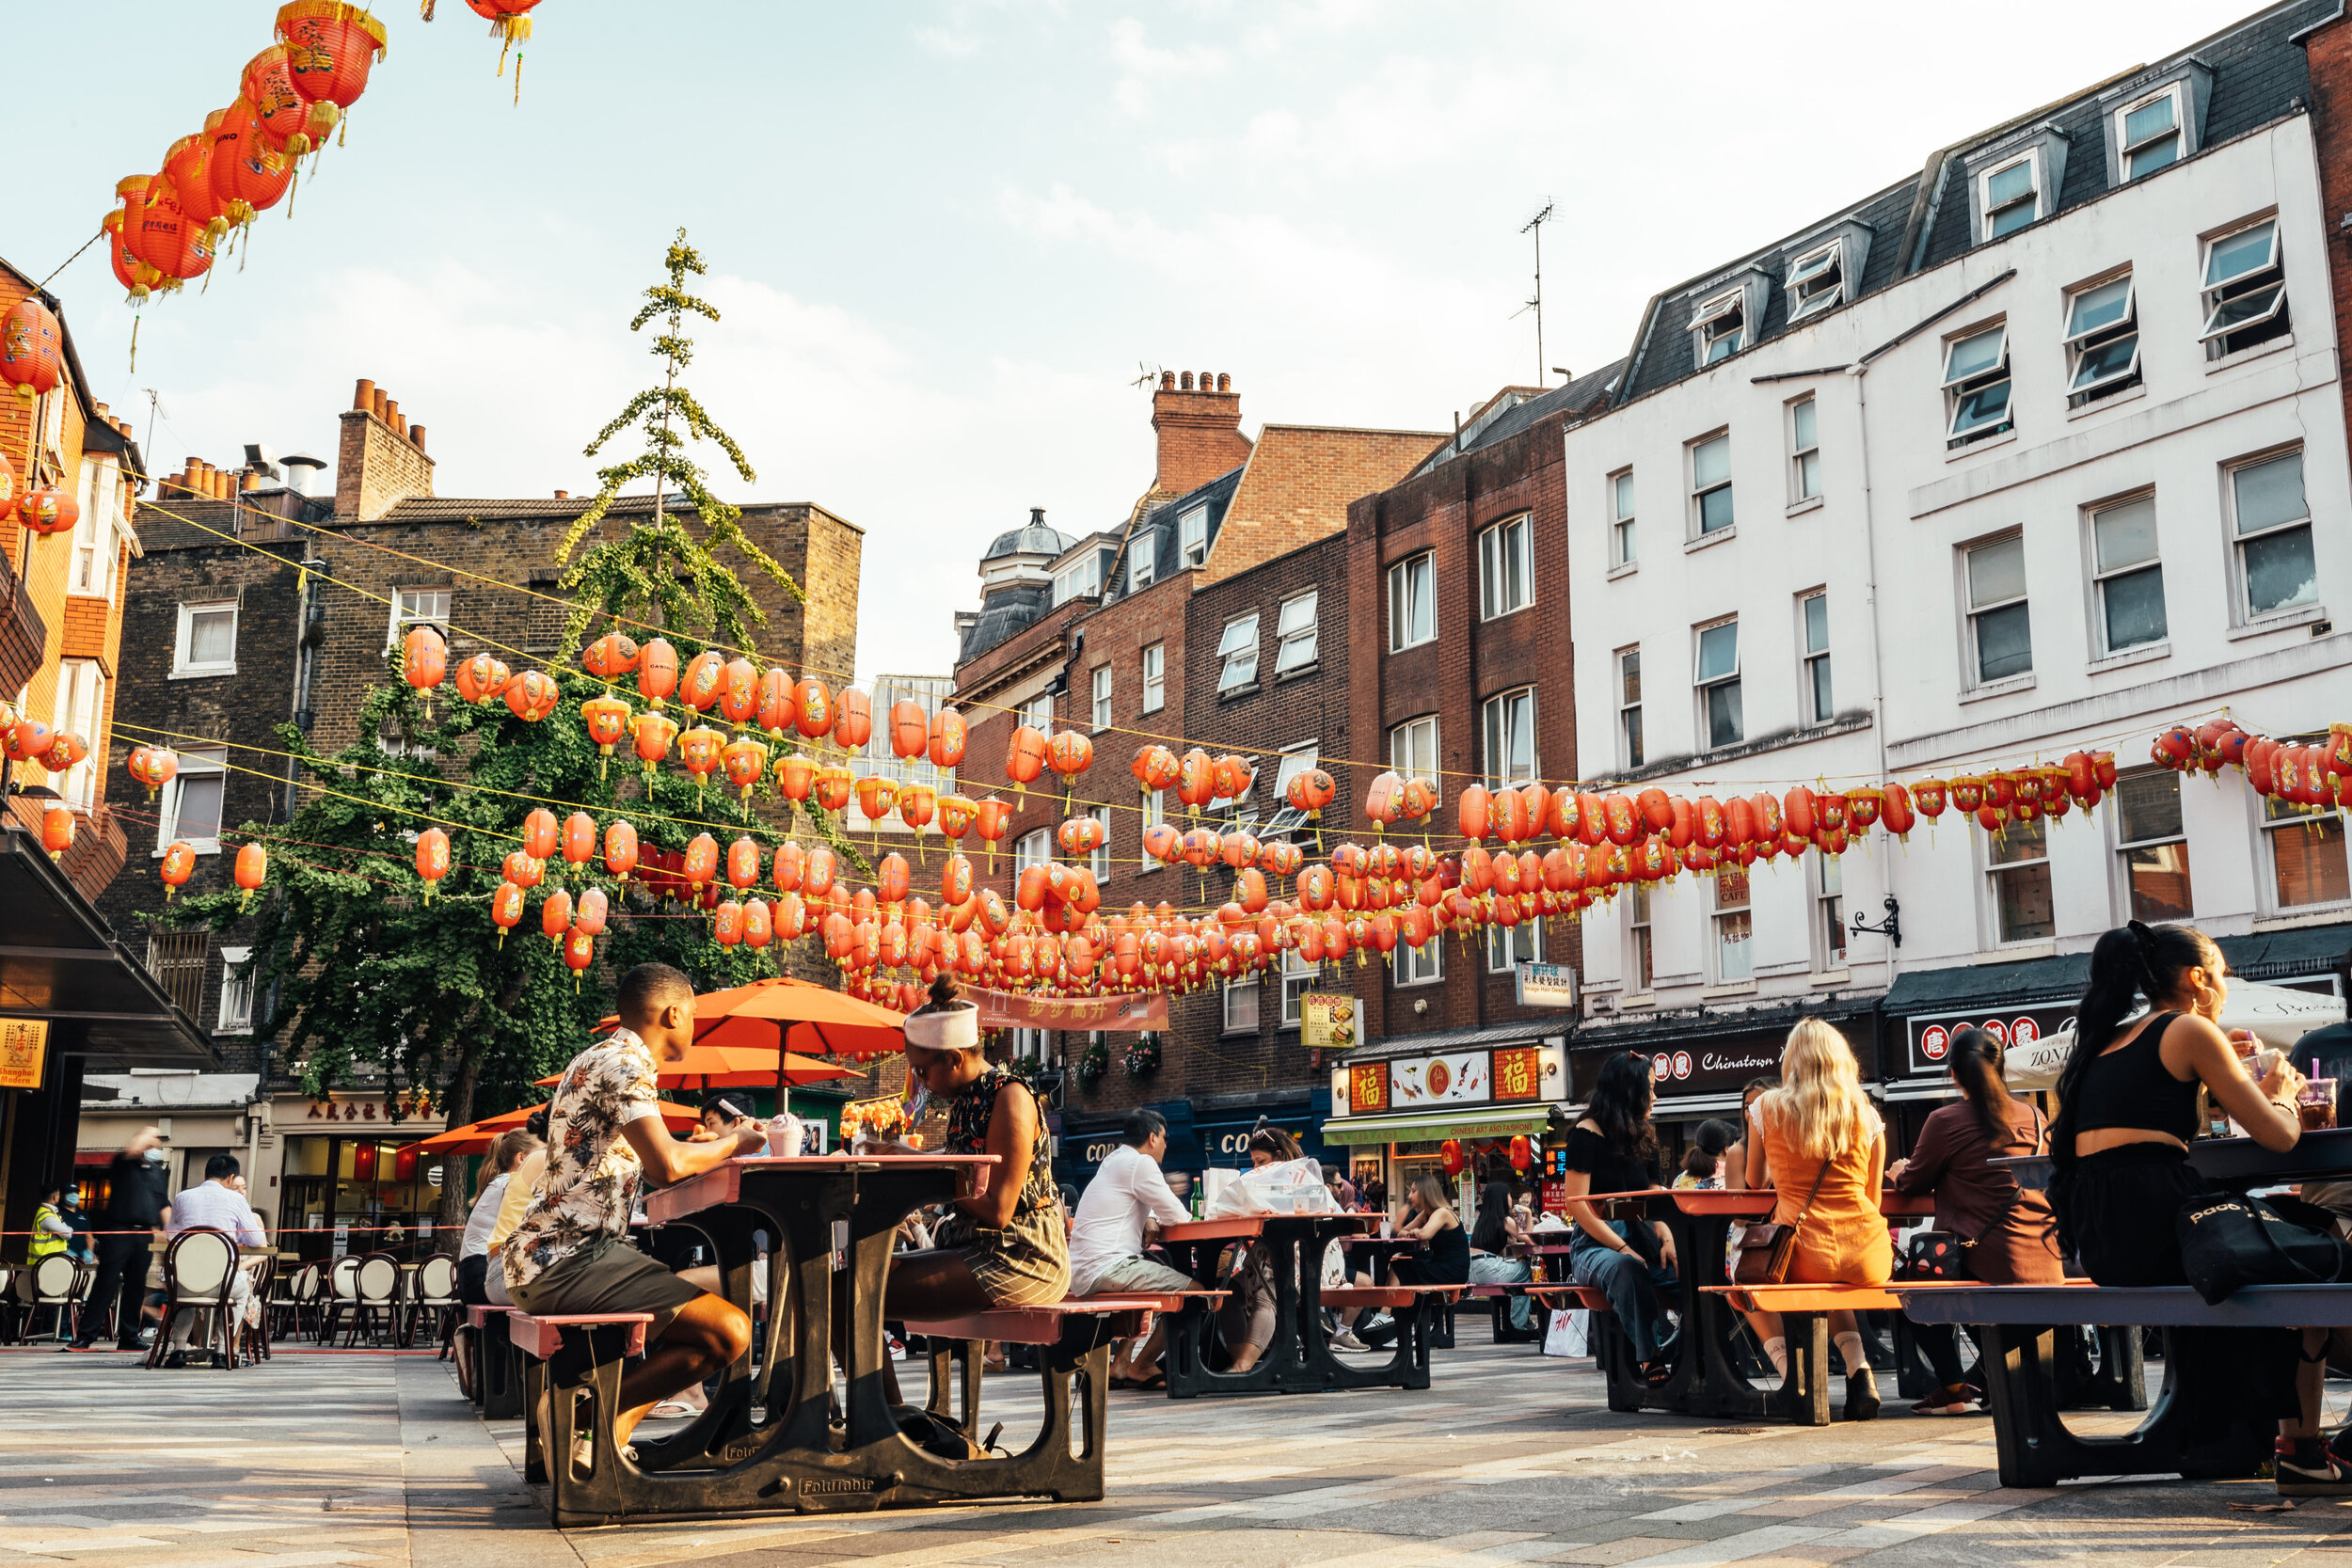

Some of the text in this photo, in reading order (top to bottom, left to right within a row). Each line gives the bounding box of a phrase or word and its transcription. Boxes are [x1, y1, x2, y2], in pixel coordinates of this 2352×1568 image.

[1019, 748, 1041, 761] CASINO
[1721, 890, 1747, 902] CAFE
[1724, 932, 1753, 945] 馬拉咖
[1551, 987, 1569, 995] Design
[1027, 999, 1108, 1021] 步步高升
[1702, 1052, 1774, 1071] Chinatown
[2030, 1045, 2072, 1067] ZONI
[0, 1067, 36, 1078] Shanghai
[1, 1075, 31, 1085] Modern
[1502, 1052, 1529, 1094] 福
[1359, 1067, 1381, 1106] 福
[1450, 1122, 1534, 1135] CHINESE ART AND FASHIONS
[1221, 1132, 1248, 1154] CO
[2189, 1203, 2241, 1225] paco
